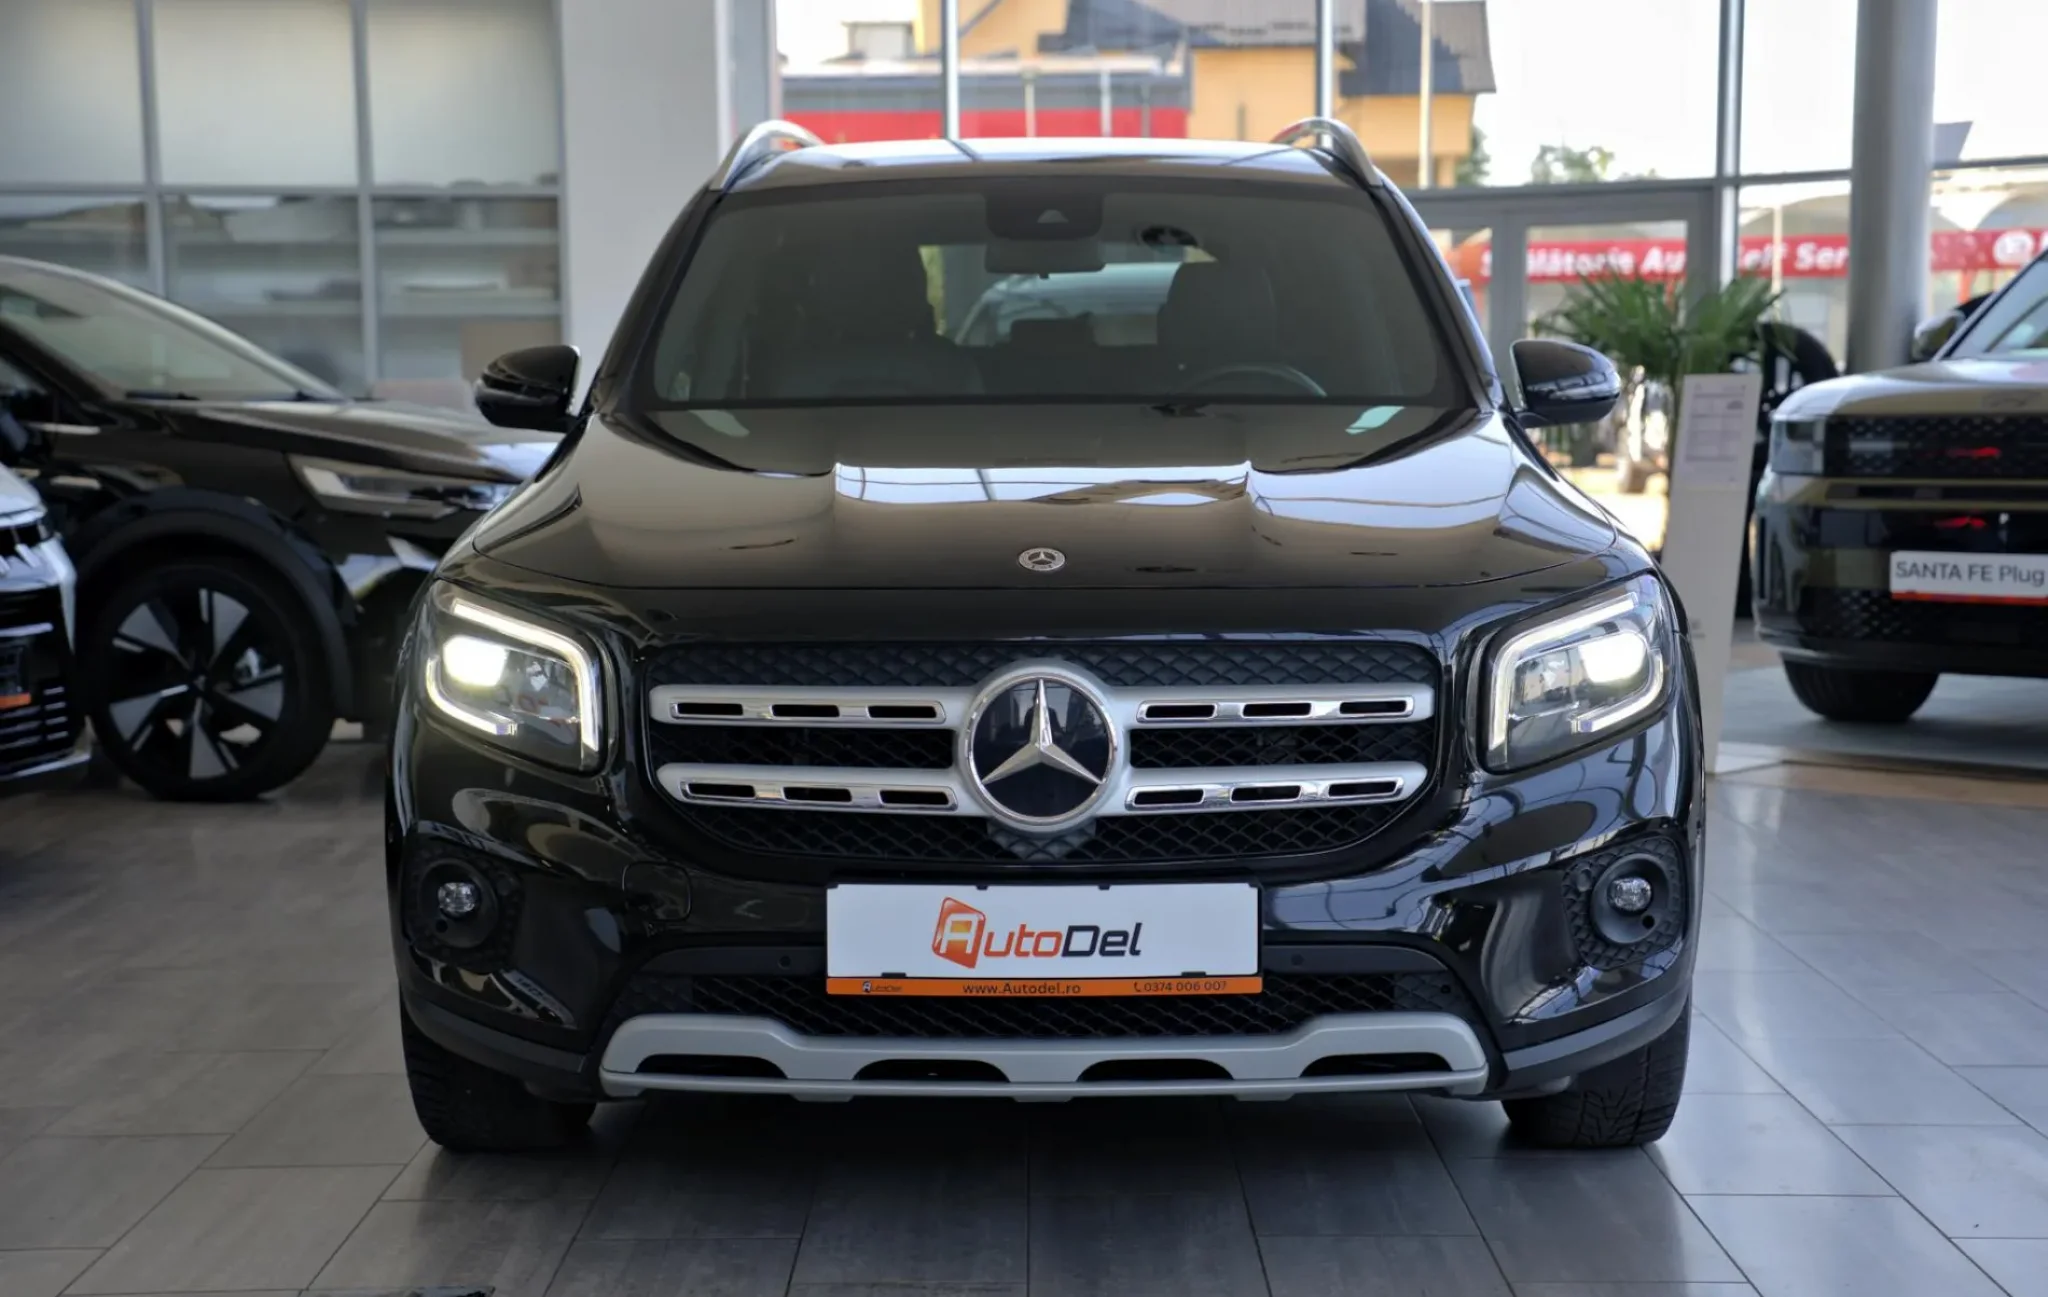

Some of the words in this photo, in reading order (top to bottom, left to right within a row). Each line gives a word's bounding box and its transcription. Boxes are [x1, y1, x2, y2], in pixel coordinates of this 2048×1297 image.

[1895, 560, 1962, 580] SANTA
[1967, 563, 1993, 582] FE
[1999, 564, 2046, 588] Plug
[939, 912, 1142, 958] AutoDel
[963, 981, 1081, 995] www.Autodel.ro
[1144, 981, 1172, 992] 0374
[1176, 981, 1201, 992] 006
[1204, 981, 1227, 992] 007
